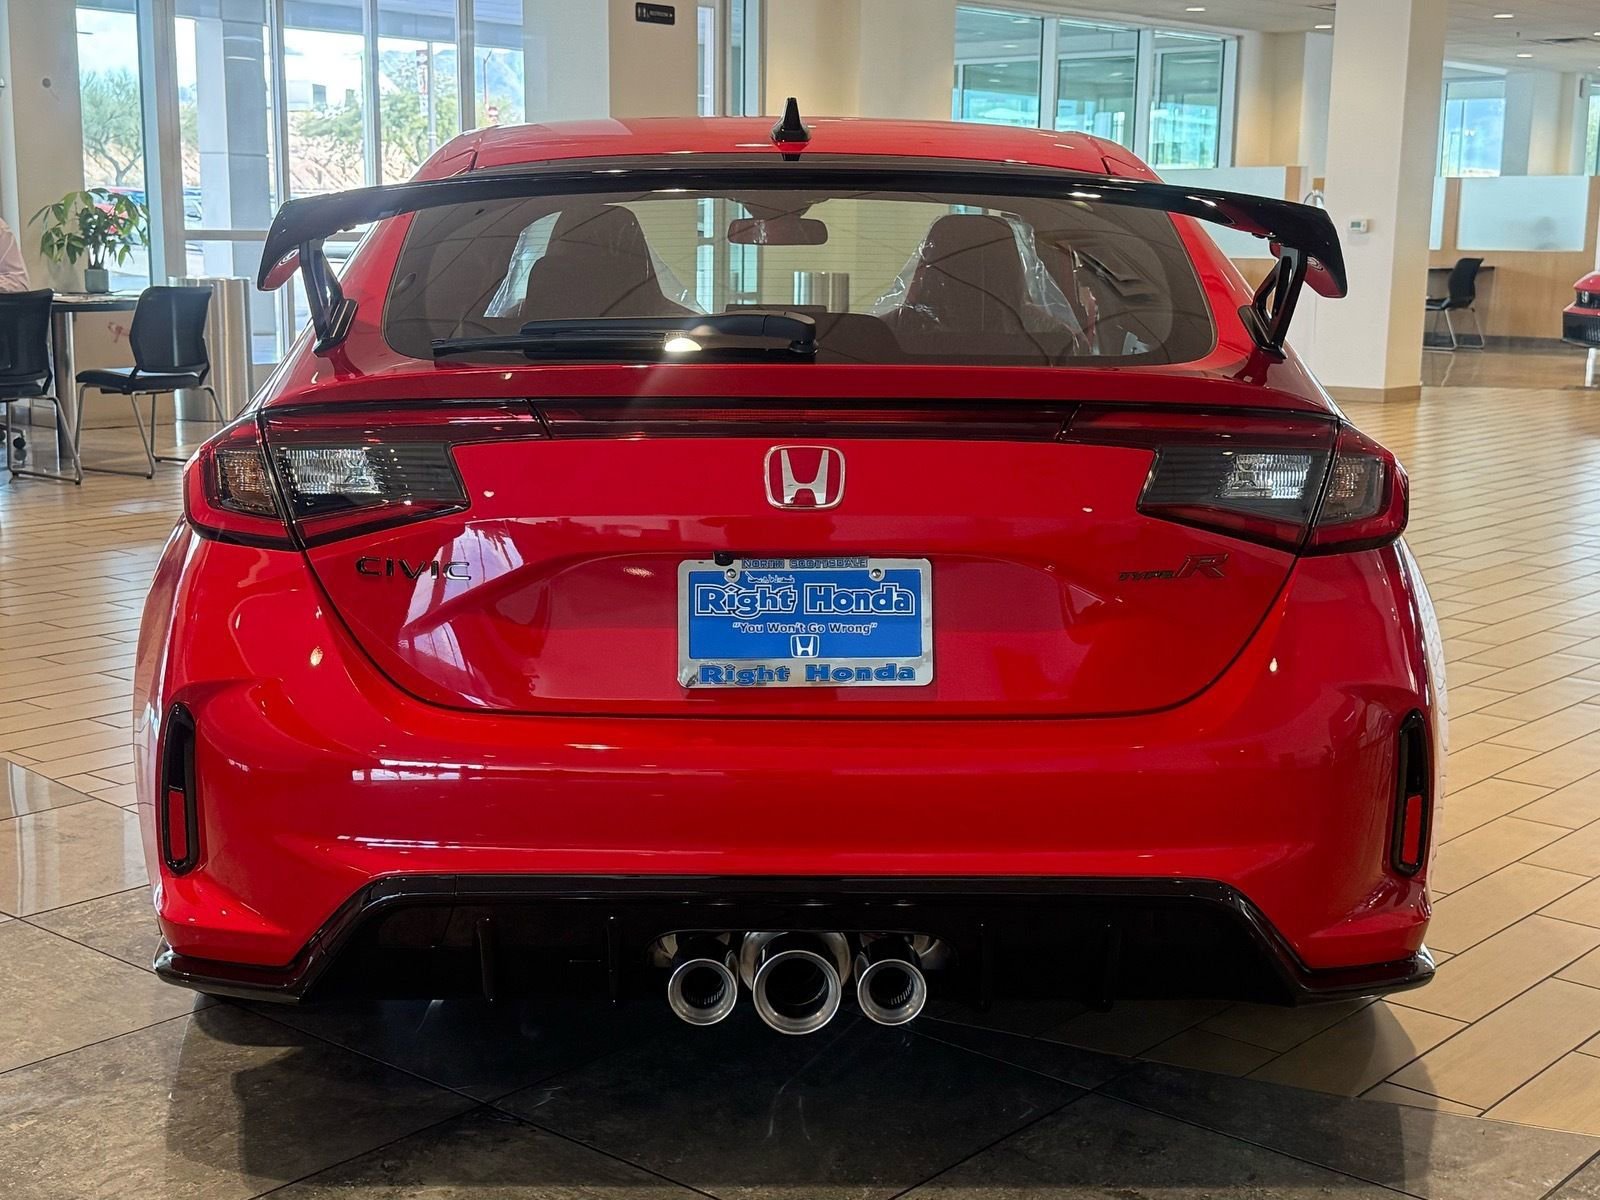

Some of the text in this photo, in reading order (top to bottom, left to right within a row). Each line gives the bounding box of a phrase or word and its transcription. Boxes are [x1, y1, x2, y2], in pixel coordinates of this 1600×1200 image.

[356, 556, 472, 581] CIVIC
[695, 583, 915, 619] Right Honda
[767, 622, 805, 633] Won't
[807, 622, 826, 633] Go
[700, 663, 916, 685] Right Honda
